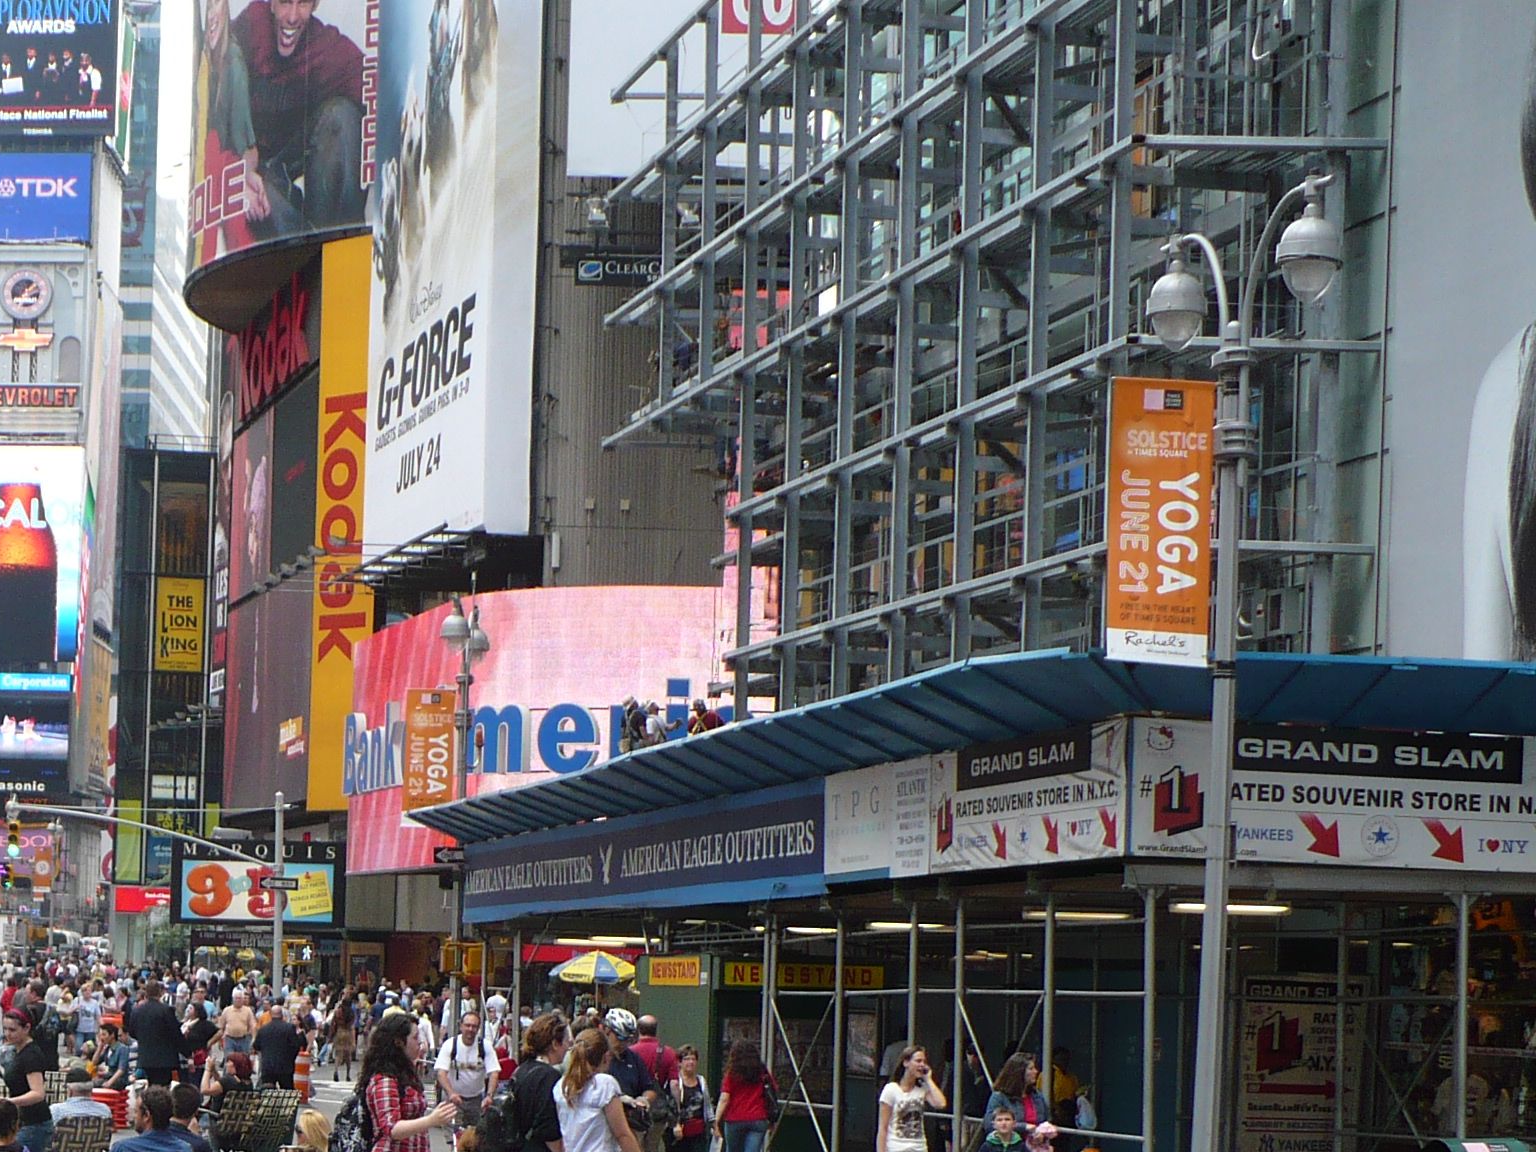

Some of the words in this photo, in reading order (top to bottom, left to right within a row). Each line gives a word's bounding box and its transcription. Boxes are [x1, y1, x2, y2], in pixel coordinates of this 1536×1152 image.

[6, 19, 77, 34] AWARDS
[23, 109, 67, 120] National
[69, 108, 108, 119] Finalist
[16, 177, 78, 197] TDK
[240, 272, 310, 420] Kodak
[376, 292, 477, 432] G-FORCE
[1127, 428, 1208, 451] SOLSTICE
[396, 442, 424, 494] JULY
[425, 432, 442, 478] 24
[1135, 448, 1157, 457] TIMES
[1159, 449, 1188, 458] SQUARE
[1120, 470, 1151, 553] JUNE
[318, 391, 368, 662] Kodak
[1158, 471, 1201, 594] YOGA
[1119, 557, 1148, 593] 21
[168, 596, 192, 608] THE
[162, 612, 197, 632] LION
[161, 636, 197, 657] KING
[1125, 631, 1186, 648] Rachel's
[2, 676, 68, 688] Corporation
[344, 700, 405, 796] Bank
[410, 733, 424, 773] JUNE
[970, 754, 1023, 777] GRAND
[1028, 741, 1075, 766] SLAM
[1238, 737, 1378, 764] GRAND
[1394, 745, 1504, 770] SLAM
[427, 733, 448, 793] YOGA
[1139, 774, 1153, 798] #
[956, 799, 984, 818] RATED
[986, 793, 1034, 814] SOUVENIR
[1036, 785, 1069, 808] STORE
[1072, 783, 1084, 802] IN
[1087, 780, 1119, 800] N.Y.C.
[1292, 788, 1404, 808] SOUVENIR
[1412, 791, 1480, 813] STORE
[1488, 795, 1511, 813] IN
[1078, 820, 1092, 835] NY
[1236, 827, 1294, 842] YANKEES
[183, 841, 337, 859] MARQUIS
[620, 840, 682, 877] AMERICAN
[683, 833, 724, 869] EAGLE
[725, 819, 815, 864] OUTFITTERS
[1502, 840, 1528, 853] NY
[464, 867, 506, 895] AMERICAN
[506, 863, 533, 891] EAGLE
[534, 854, 592, 887] OUTFITTERS
[651, 960, 695, 980] NEWSSTAND
[1278, 1139, 1332, 1152] YANKEES
